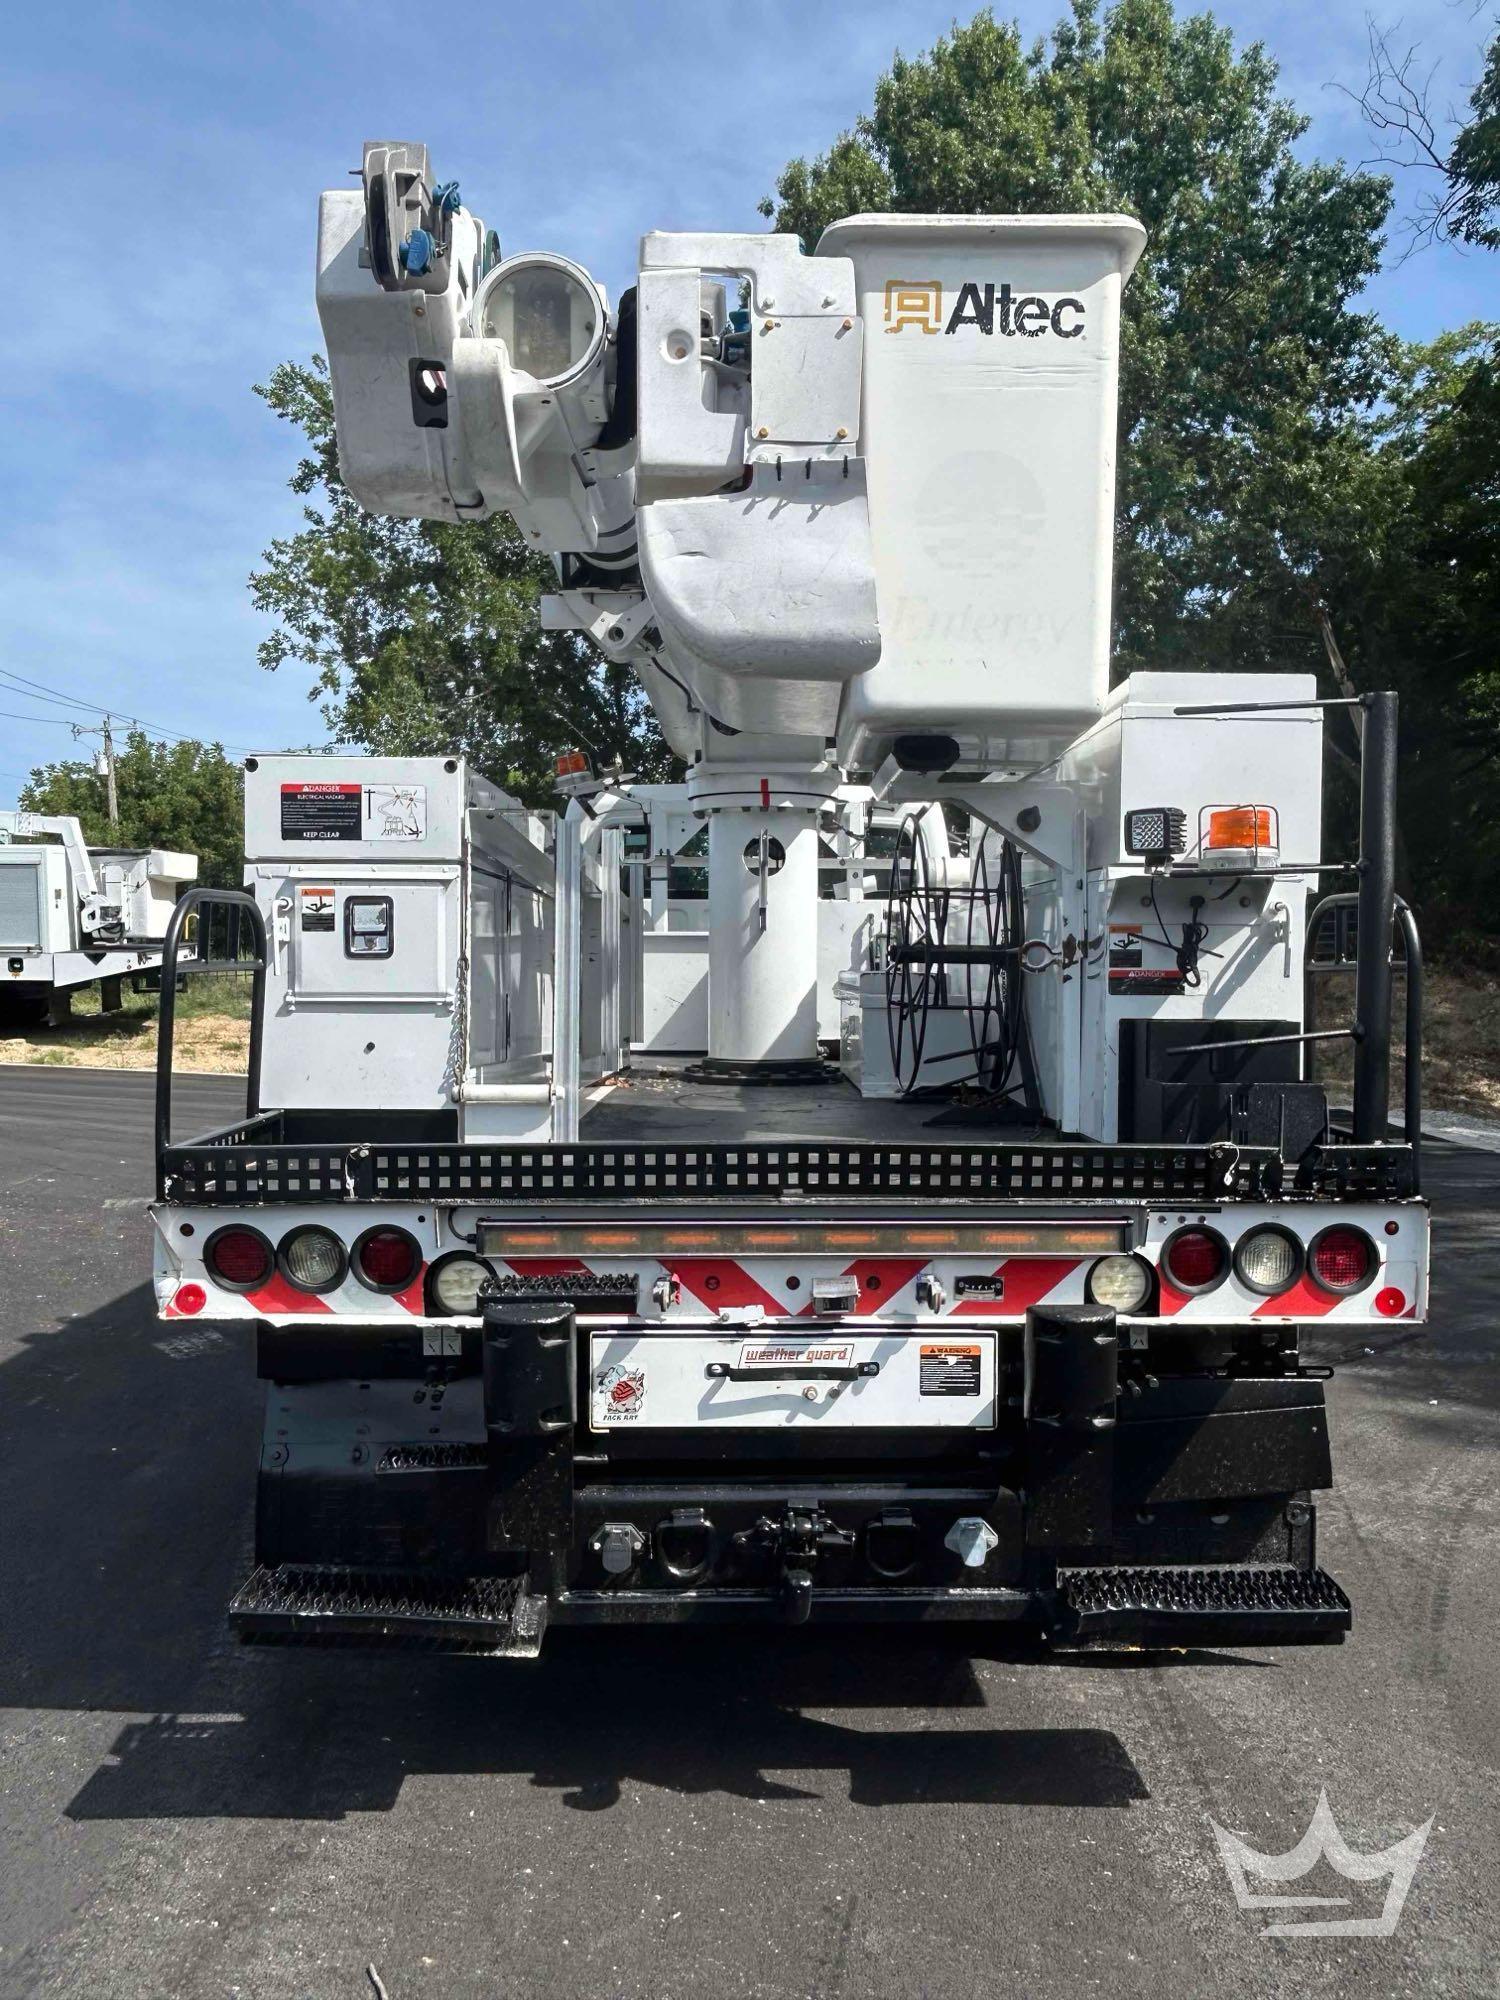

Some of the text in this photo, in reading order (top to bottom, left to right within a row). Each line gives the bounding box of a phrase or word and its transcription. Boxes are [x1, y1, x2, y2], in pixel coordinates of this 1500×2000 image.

[945, 282, 1085, 339] Altec
[746, 1347, 848, 1362] weather guard
